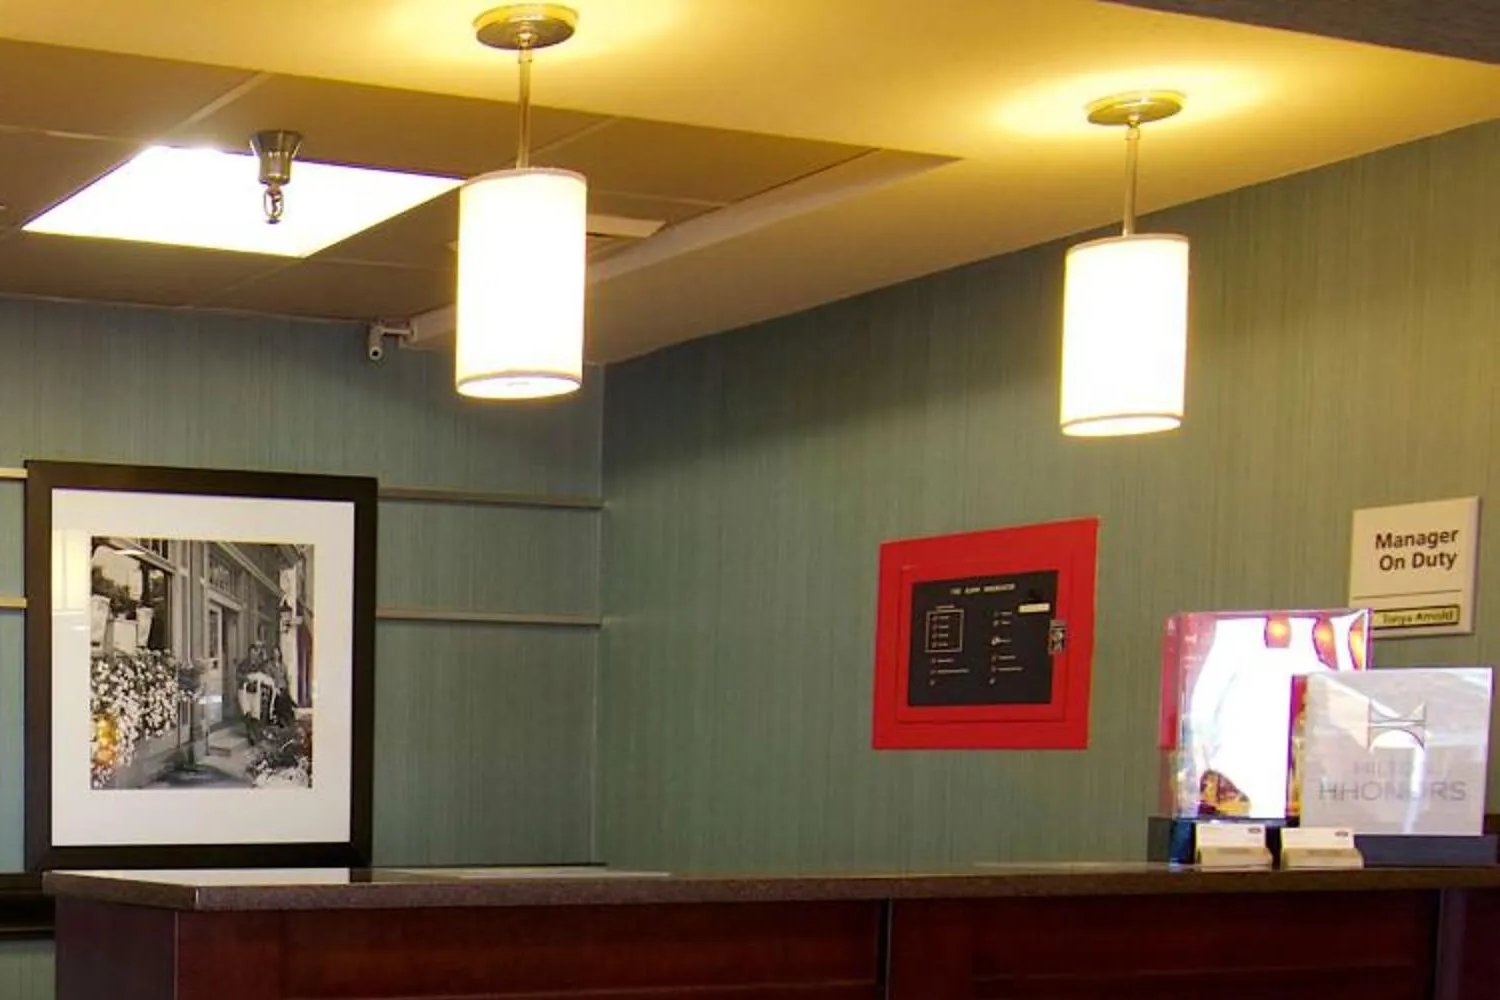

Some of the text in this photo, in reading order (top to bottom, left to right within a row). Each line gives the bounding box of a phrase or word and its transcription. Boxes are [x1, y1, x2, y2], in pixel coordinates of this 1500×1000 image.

[1375, 529, 1460, 550] Manager
[1379, 551, 1458, 571] On Duty
[1318, 780, 1468, 802] HHONRS
